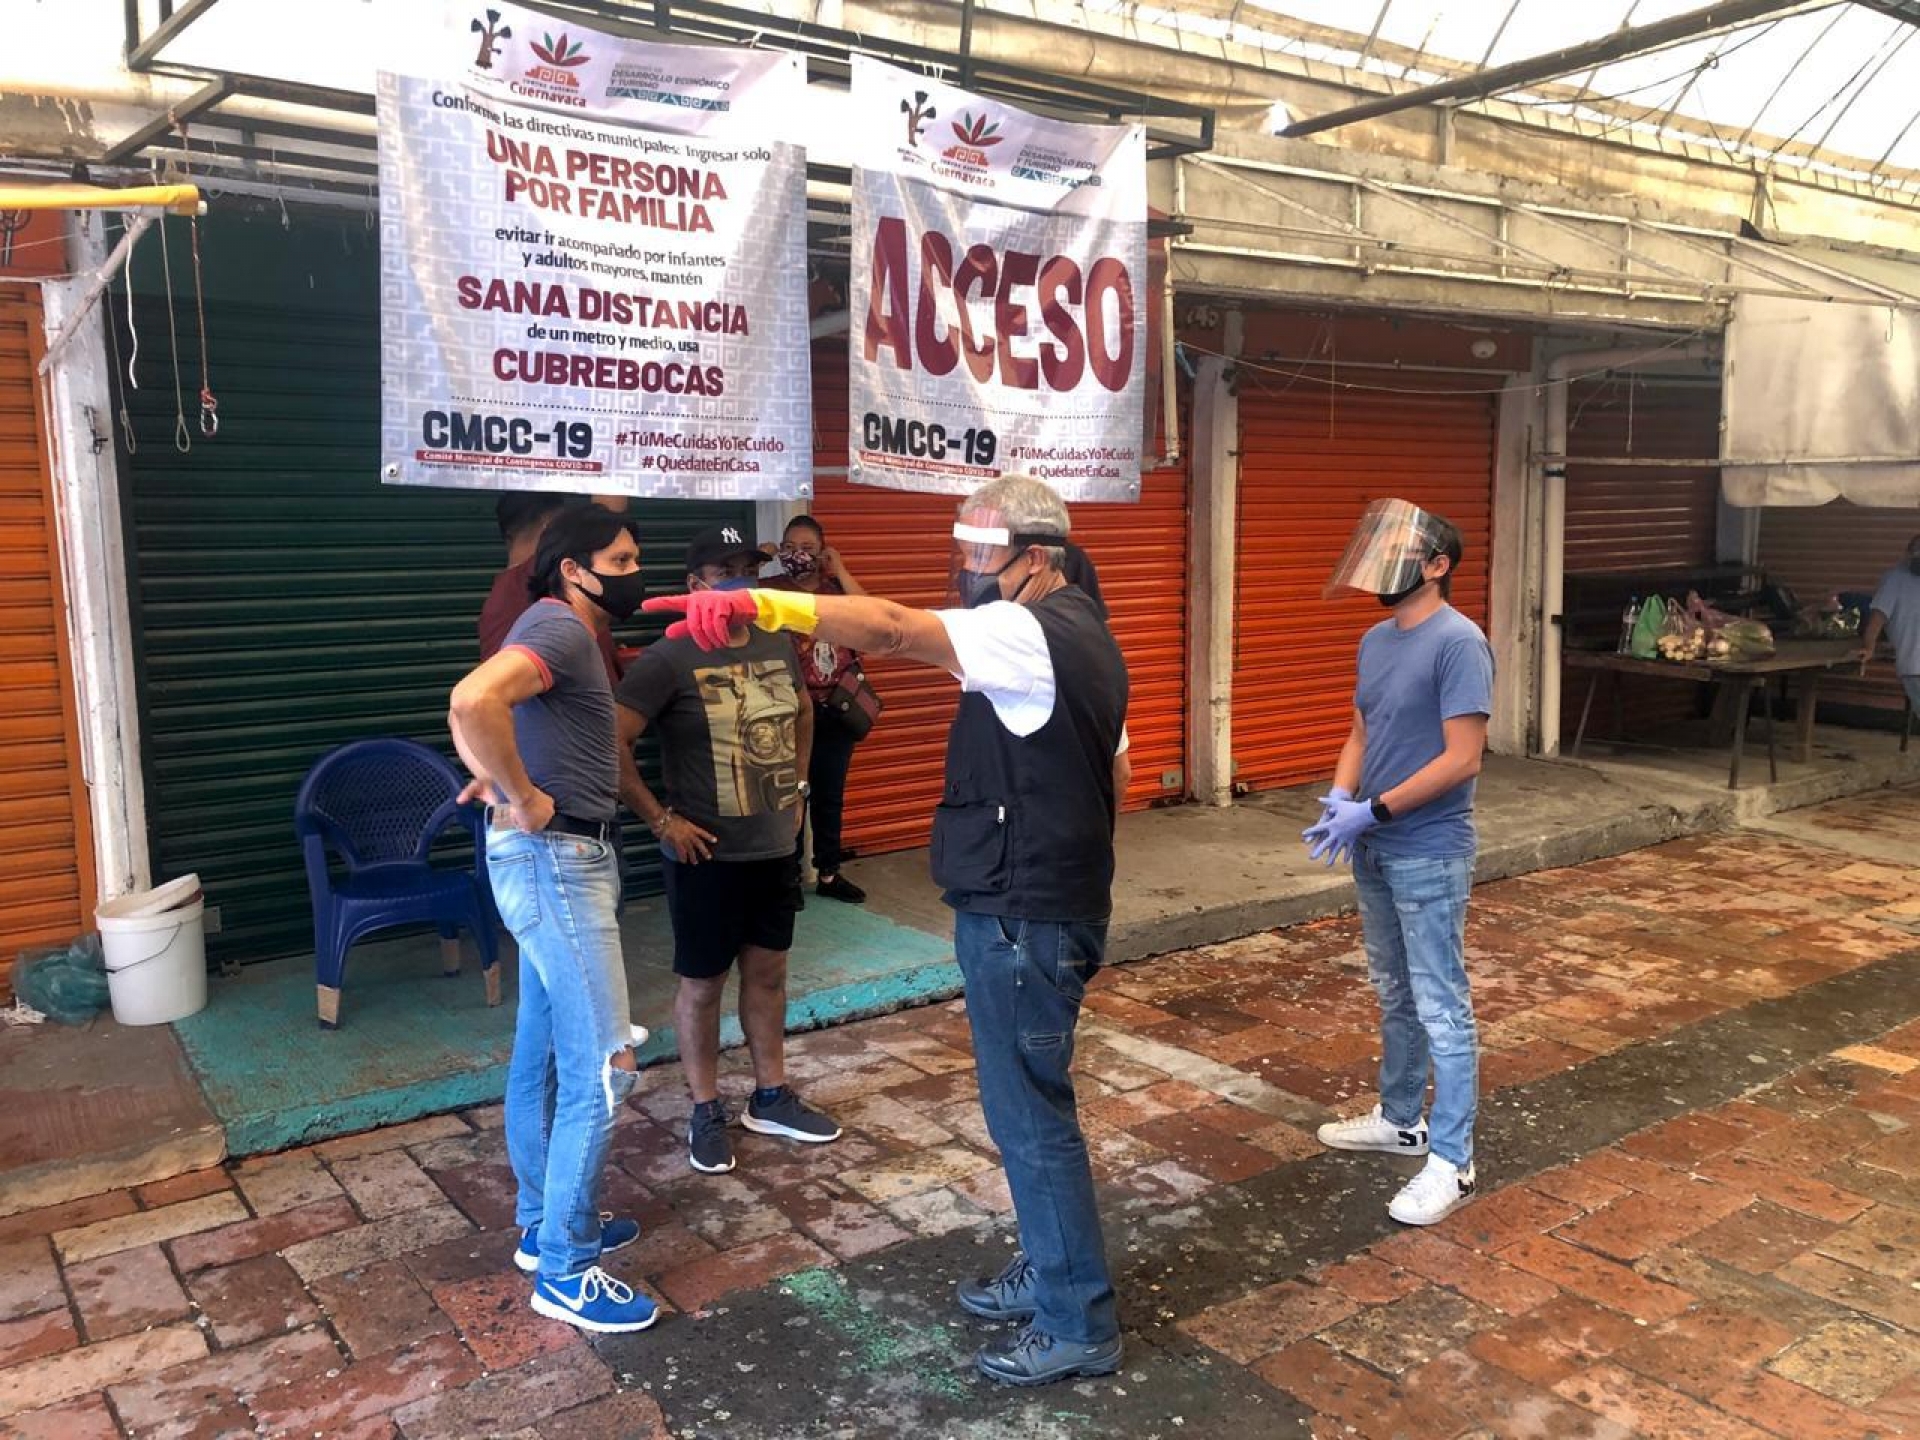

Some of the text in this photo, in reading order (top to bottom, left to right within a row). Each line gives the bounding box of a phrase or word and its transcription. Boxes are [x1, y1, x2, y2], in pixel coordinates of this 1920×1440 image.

[509, 81, 587, 107] Cuernavaca
[432, 90, 501, 124] Conforme
[503, 111, 524, 129] las
[526, 116, 594, 141] directivas
[685, 145, 739, 163] Ingresar
[742, 147, 772, 162] solo
[486, 129, 729, 200] UNA PERSONA
[930, 161, 996, 188] Cuernavaca
[505, 169, 715, 234] POR FAMILIA
[494, 226, 727, 268] evitar ir acompañado por infantes
[522, 251, 703, 286] y adultos mayores, mantén
[457, 275, 750, 336] SANA DISTANCIA
[864, 216, 1134, 392] ACCESO
[527, 322, 701, 354] de un metro y medio, usa
[492, 348, 725, 397] CUBREBOCAS
[422, 410, 593, 459] CMCC-19
[863, 412, 997, 466] CMCC-19
[422, 451, 453, 460] Comité
[454, 452, 493, 465] Municipal
[505, 457, 554, 469] Contingencia
